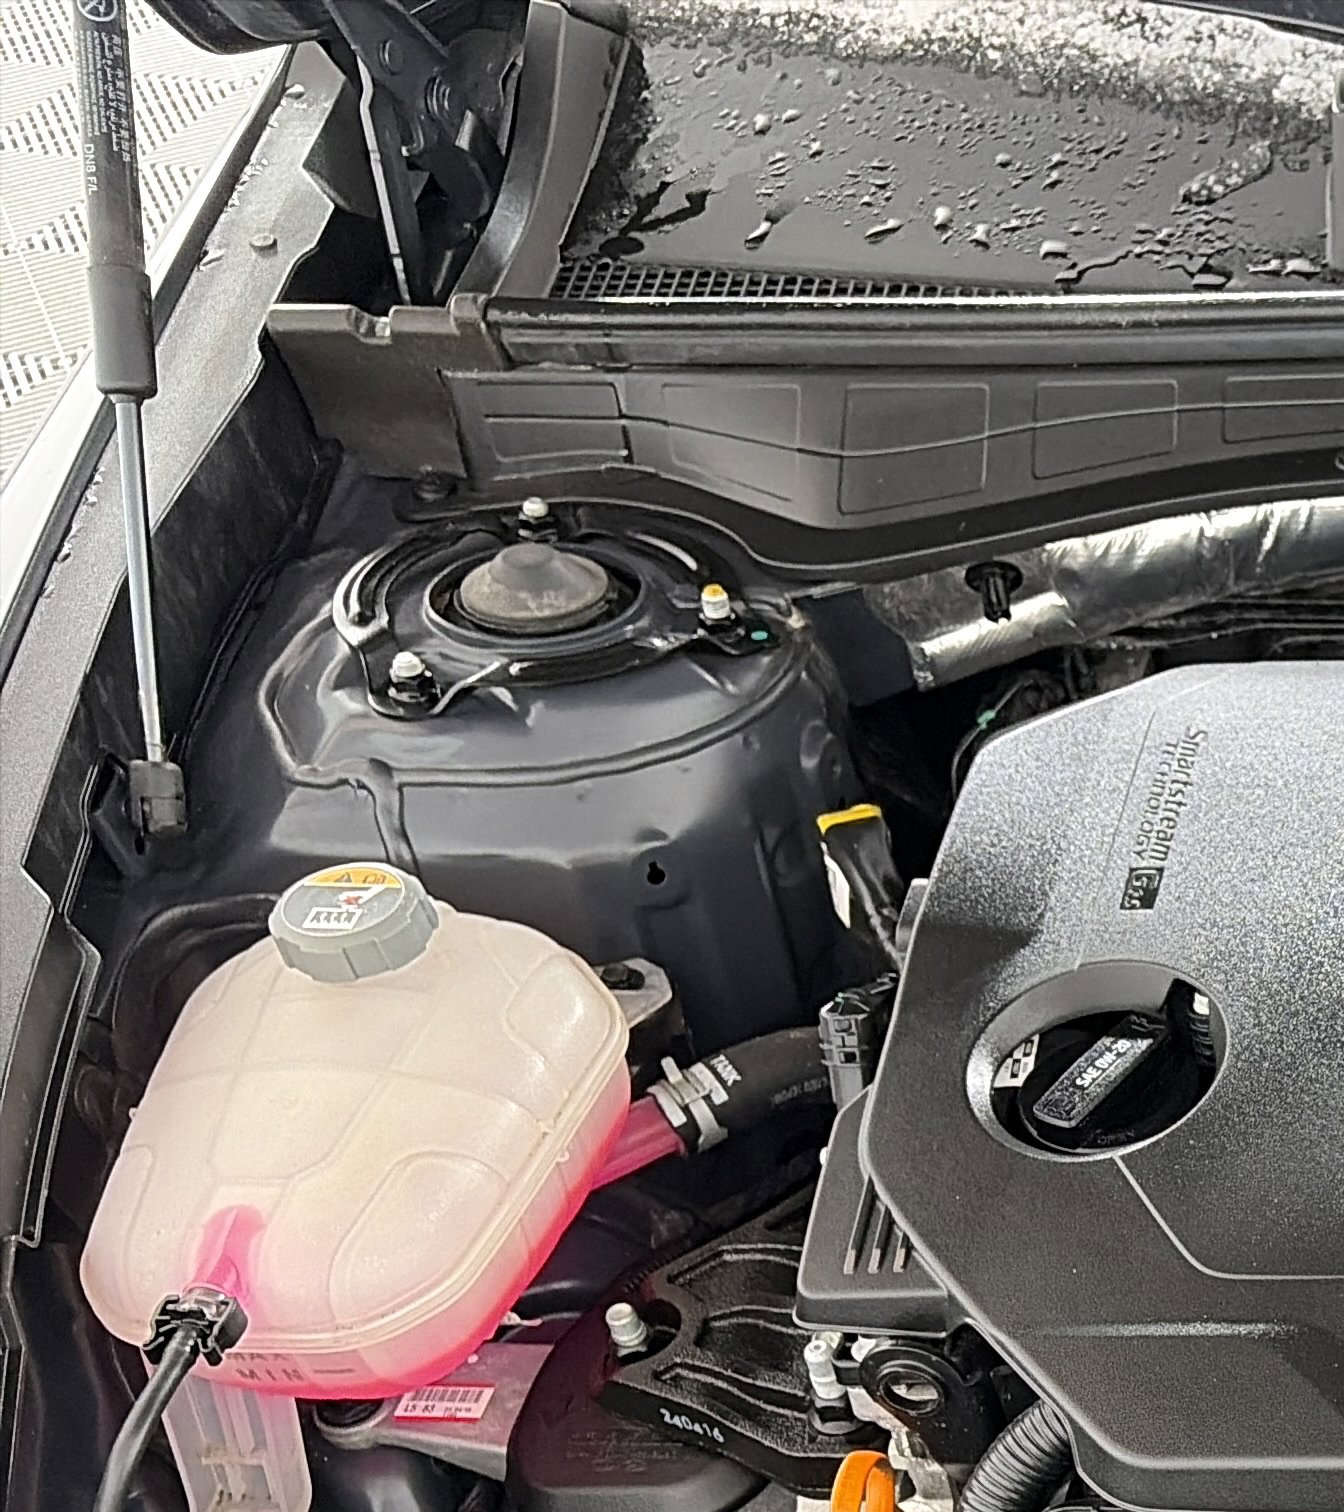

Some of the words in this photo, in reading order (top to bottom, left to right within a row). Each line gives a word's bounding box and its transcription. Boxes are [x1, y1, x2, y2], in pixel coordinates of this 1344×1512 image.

[84, 144, 97, 172] DN8
[1149, 726, 1208, 862] Smartstream
[1075, 1067, 1101, 1088] SAE
[236, 1368, 304, 1381] MIN
